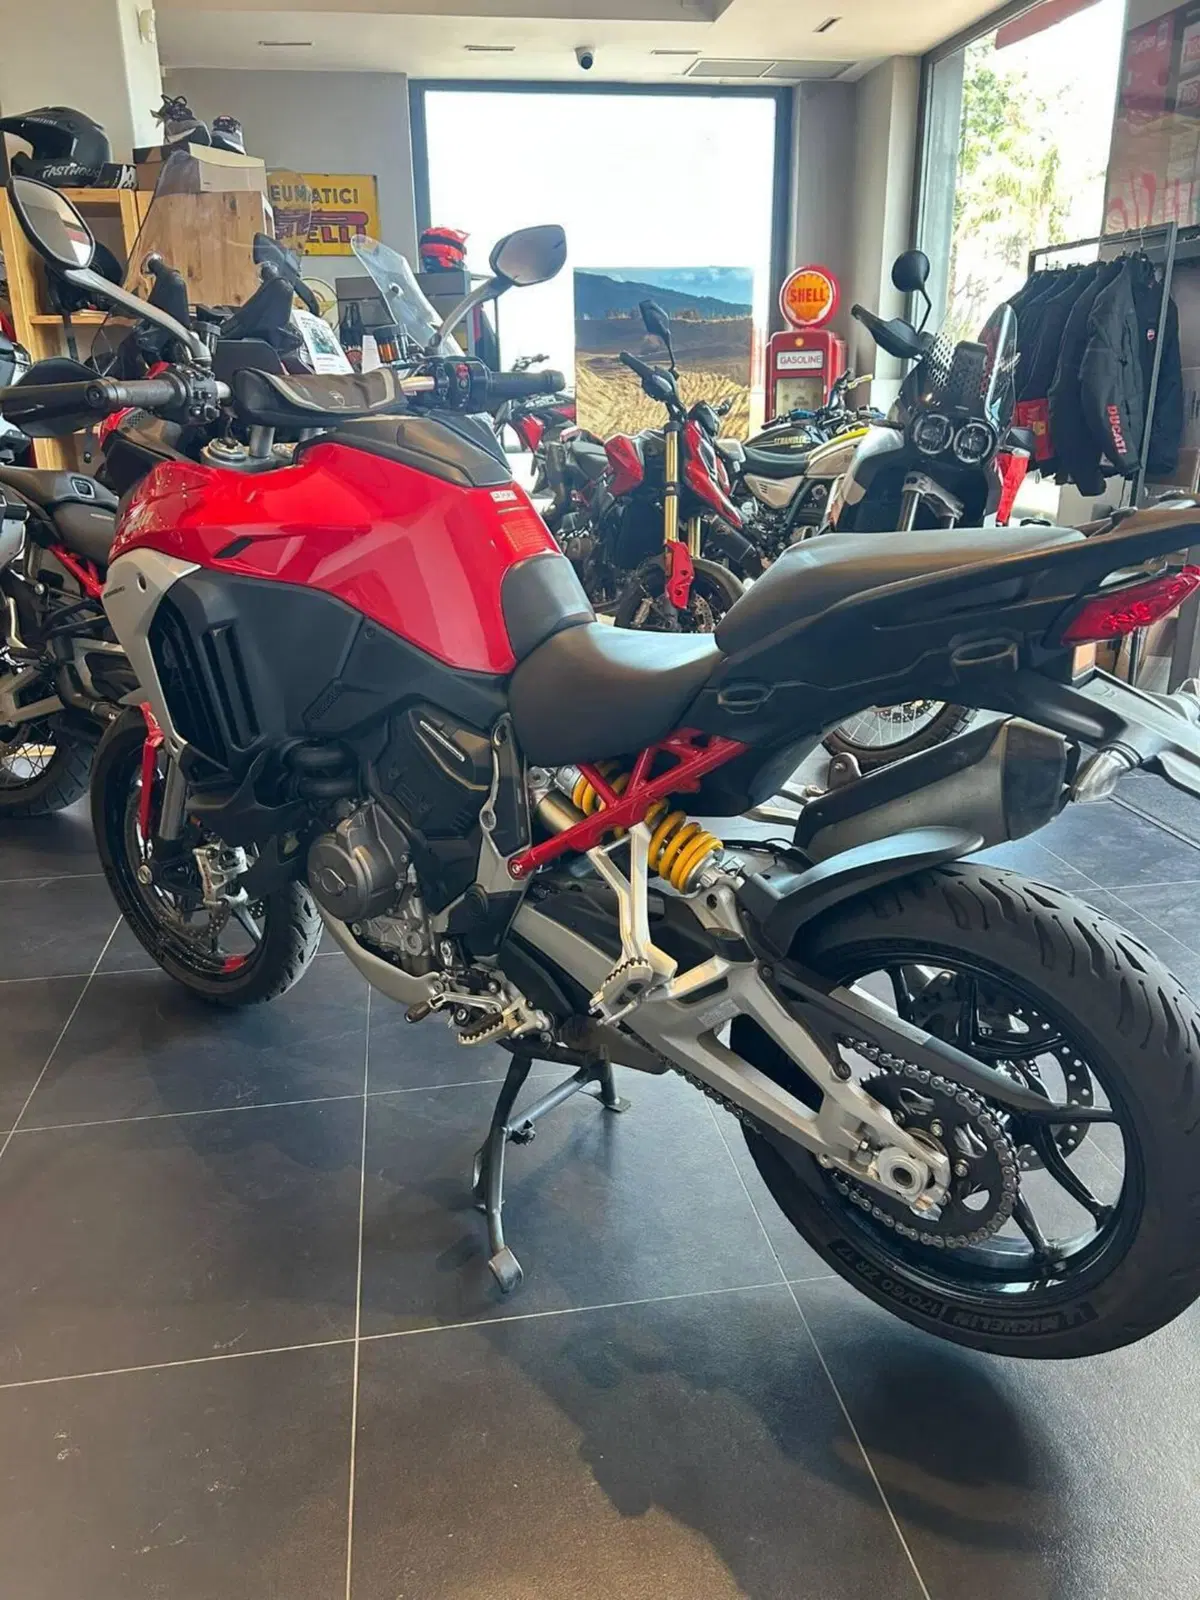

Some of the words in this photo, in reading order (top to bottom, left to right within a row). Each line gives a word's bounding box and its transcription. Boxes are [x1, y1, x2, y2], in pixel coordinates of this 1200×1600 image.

[42, 163, 100, 179] FASTHOUS
[269, 184, 359, 205] EUMATICI
[789, 287, 826, 303] SHELL
[779, 354, 822, 365] GASOLINE
[1106, 403, 1128, 455] DUCATI
[952, 1311, 1060, 1333] MICHELIN
